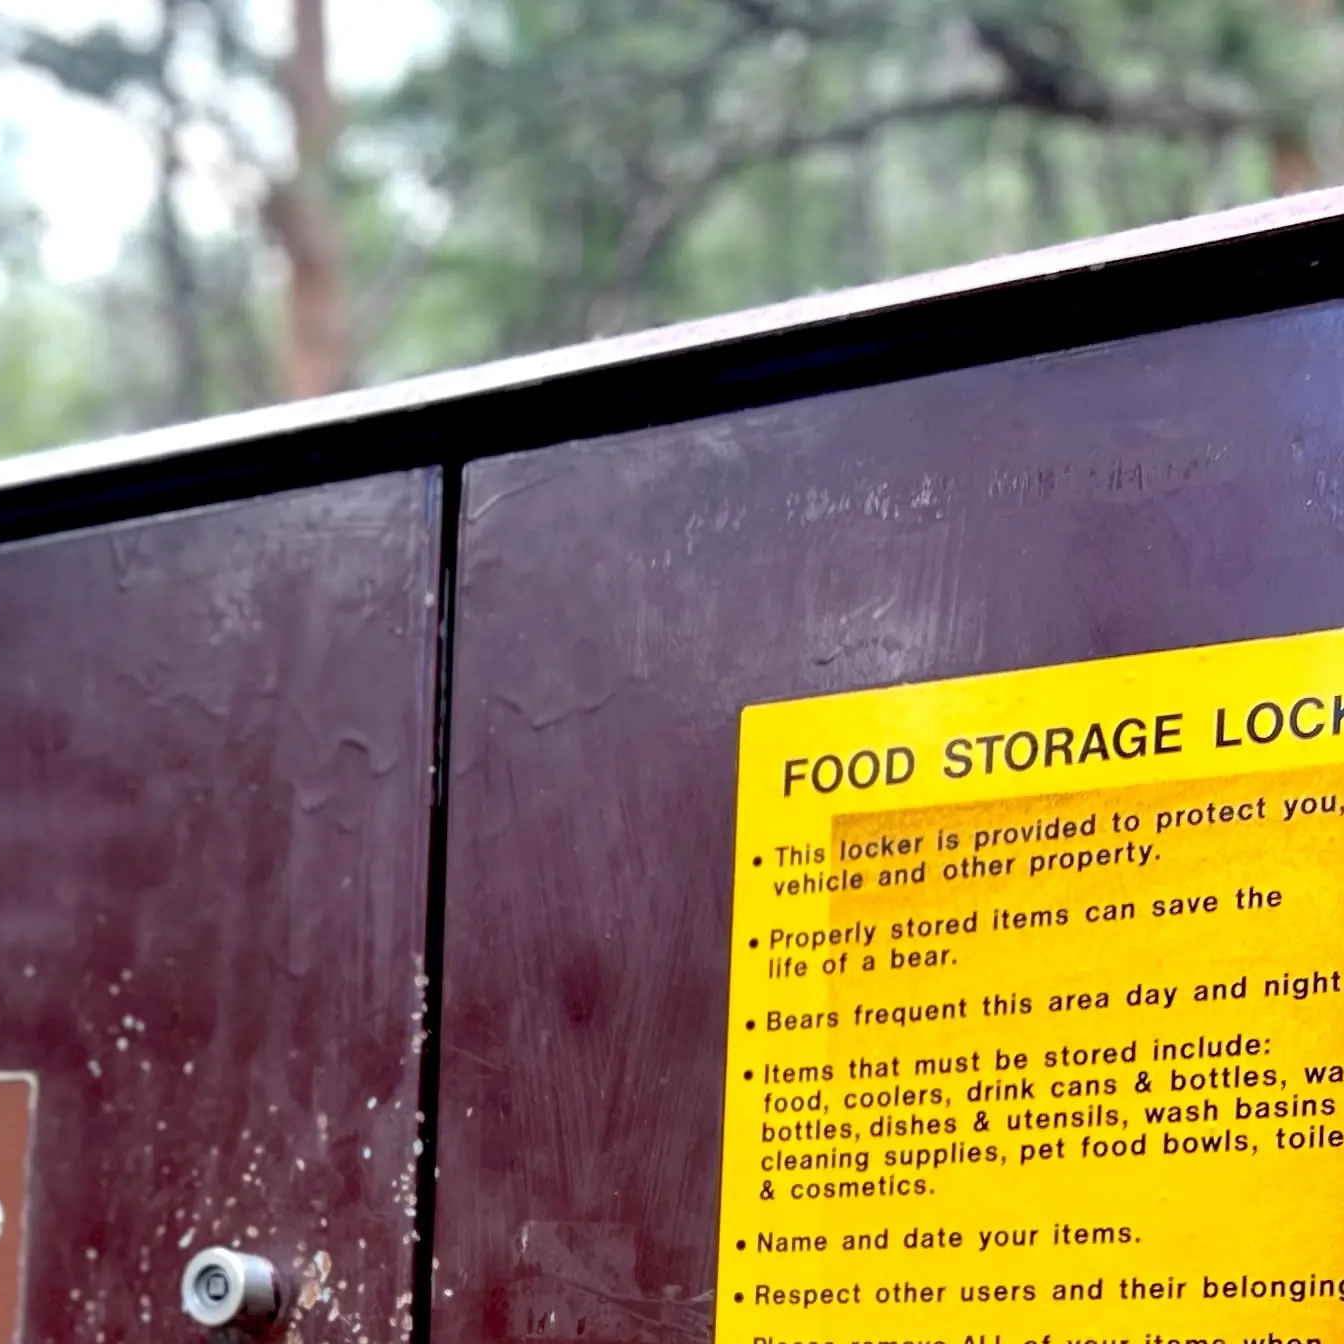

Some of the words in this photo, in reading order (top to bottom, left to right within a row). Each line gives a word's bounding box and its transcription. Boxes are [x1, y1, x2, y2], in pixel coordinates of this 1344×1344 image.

[783, 747, 915, 798] FOOD
[943, 713, 1183, 779] STORAGE
[776, 846, 825, 867] This
[840, 835, 924, 861] locker
[937, 829, 959, 851] is
[974, 813, 1096, 853] provided
[1112, 812, 1140, 833] to
[1156, 797, 1266, 834] protect
[774, 869, 864, 896] vehicle
[878, 861, 926, 887] and
[943, 855, 1016, 881] other
[1029, 841, 1161, 877] property.
[770, 921, 876, 950] Properly
[891, 911, 978, 940] stored
[993, 908, 1069, 931] items
[1085, 903, 1135, 923] can
[1151, 895, 1218, 918] save
[1235, 886, 1283, 910] the
[769, 957, 808, 978] life
[822, 952, 847, 974] of
[861, 955, 875, 972] a
[890, 948, 957, 969] bear.
[766, 1011, 839, 1031] Bears
[854, 998, 967, 1027] frequent
[982, 994, 1032, 1017] this
[1048, 992, 1109, 1012] area
[1126, 983, 1178, 1009] day
[1193, 975, 1247, 1002] and
[764, 1064, 834, 1084] Items
[849, 1057, 900, 1079] that
[915, 1051, 980, 1076] must
[995, 1049, 1028, 1071] be
[1044, 1040, 1137, 1068] stored
[1153, 1033, 1270, 1062] include:
[764, 1090, 829, 1114] food,
[843, 1085, 951, 1109] coolers,
[967, 1077, 1035, 1103] drink
[1050, 1078, 1117, 1098] cans
[1134, 1070, 1152, 1094] &
[1170, 1065, 1287, 1092] bottles,
[762, 1119, 860, 1143] bottles,
[869, 1114, 957, 1138] dishes
[973, 1110, 990, 1133] &
[1007, 1104, 1128, 1131] utensils,
[1144, 1099, 1218, 1125] wash
[1235, 1094, 1336, 1120] basins
[761, 1147, 869, 1173] cleaning
[884, 1142, 1006, 1170] supplies,
[1020, 1138, 1065, 1166] pet
[1081, 1133, 1147, 1158] food
[1163, 1129, 1258, 1155] bowls,
[759, 1179, 775, 1201] &
[790, 1174, 935, 1200] cosmetics.
[757, 1232, 828, 1253] Name
[842, 1228, 889, 1251] and
[903, 1227, 963, 1249] date
[979, 1229, 1039, 1252] your
[1054, 1223, 1140, 1245] items.
[755, 1283, 861, 1309] Respect
[875, 1281, 946, 1304] other
[960, 1284, 1036, 1302] users
[1052, 1277, 1103, 1301] and
[1119, 1276, 1187, 1300] their
